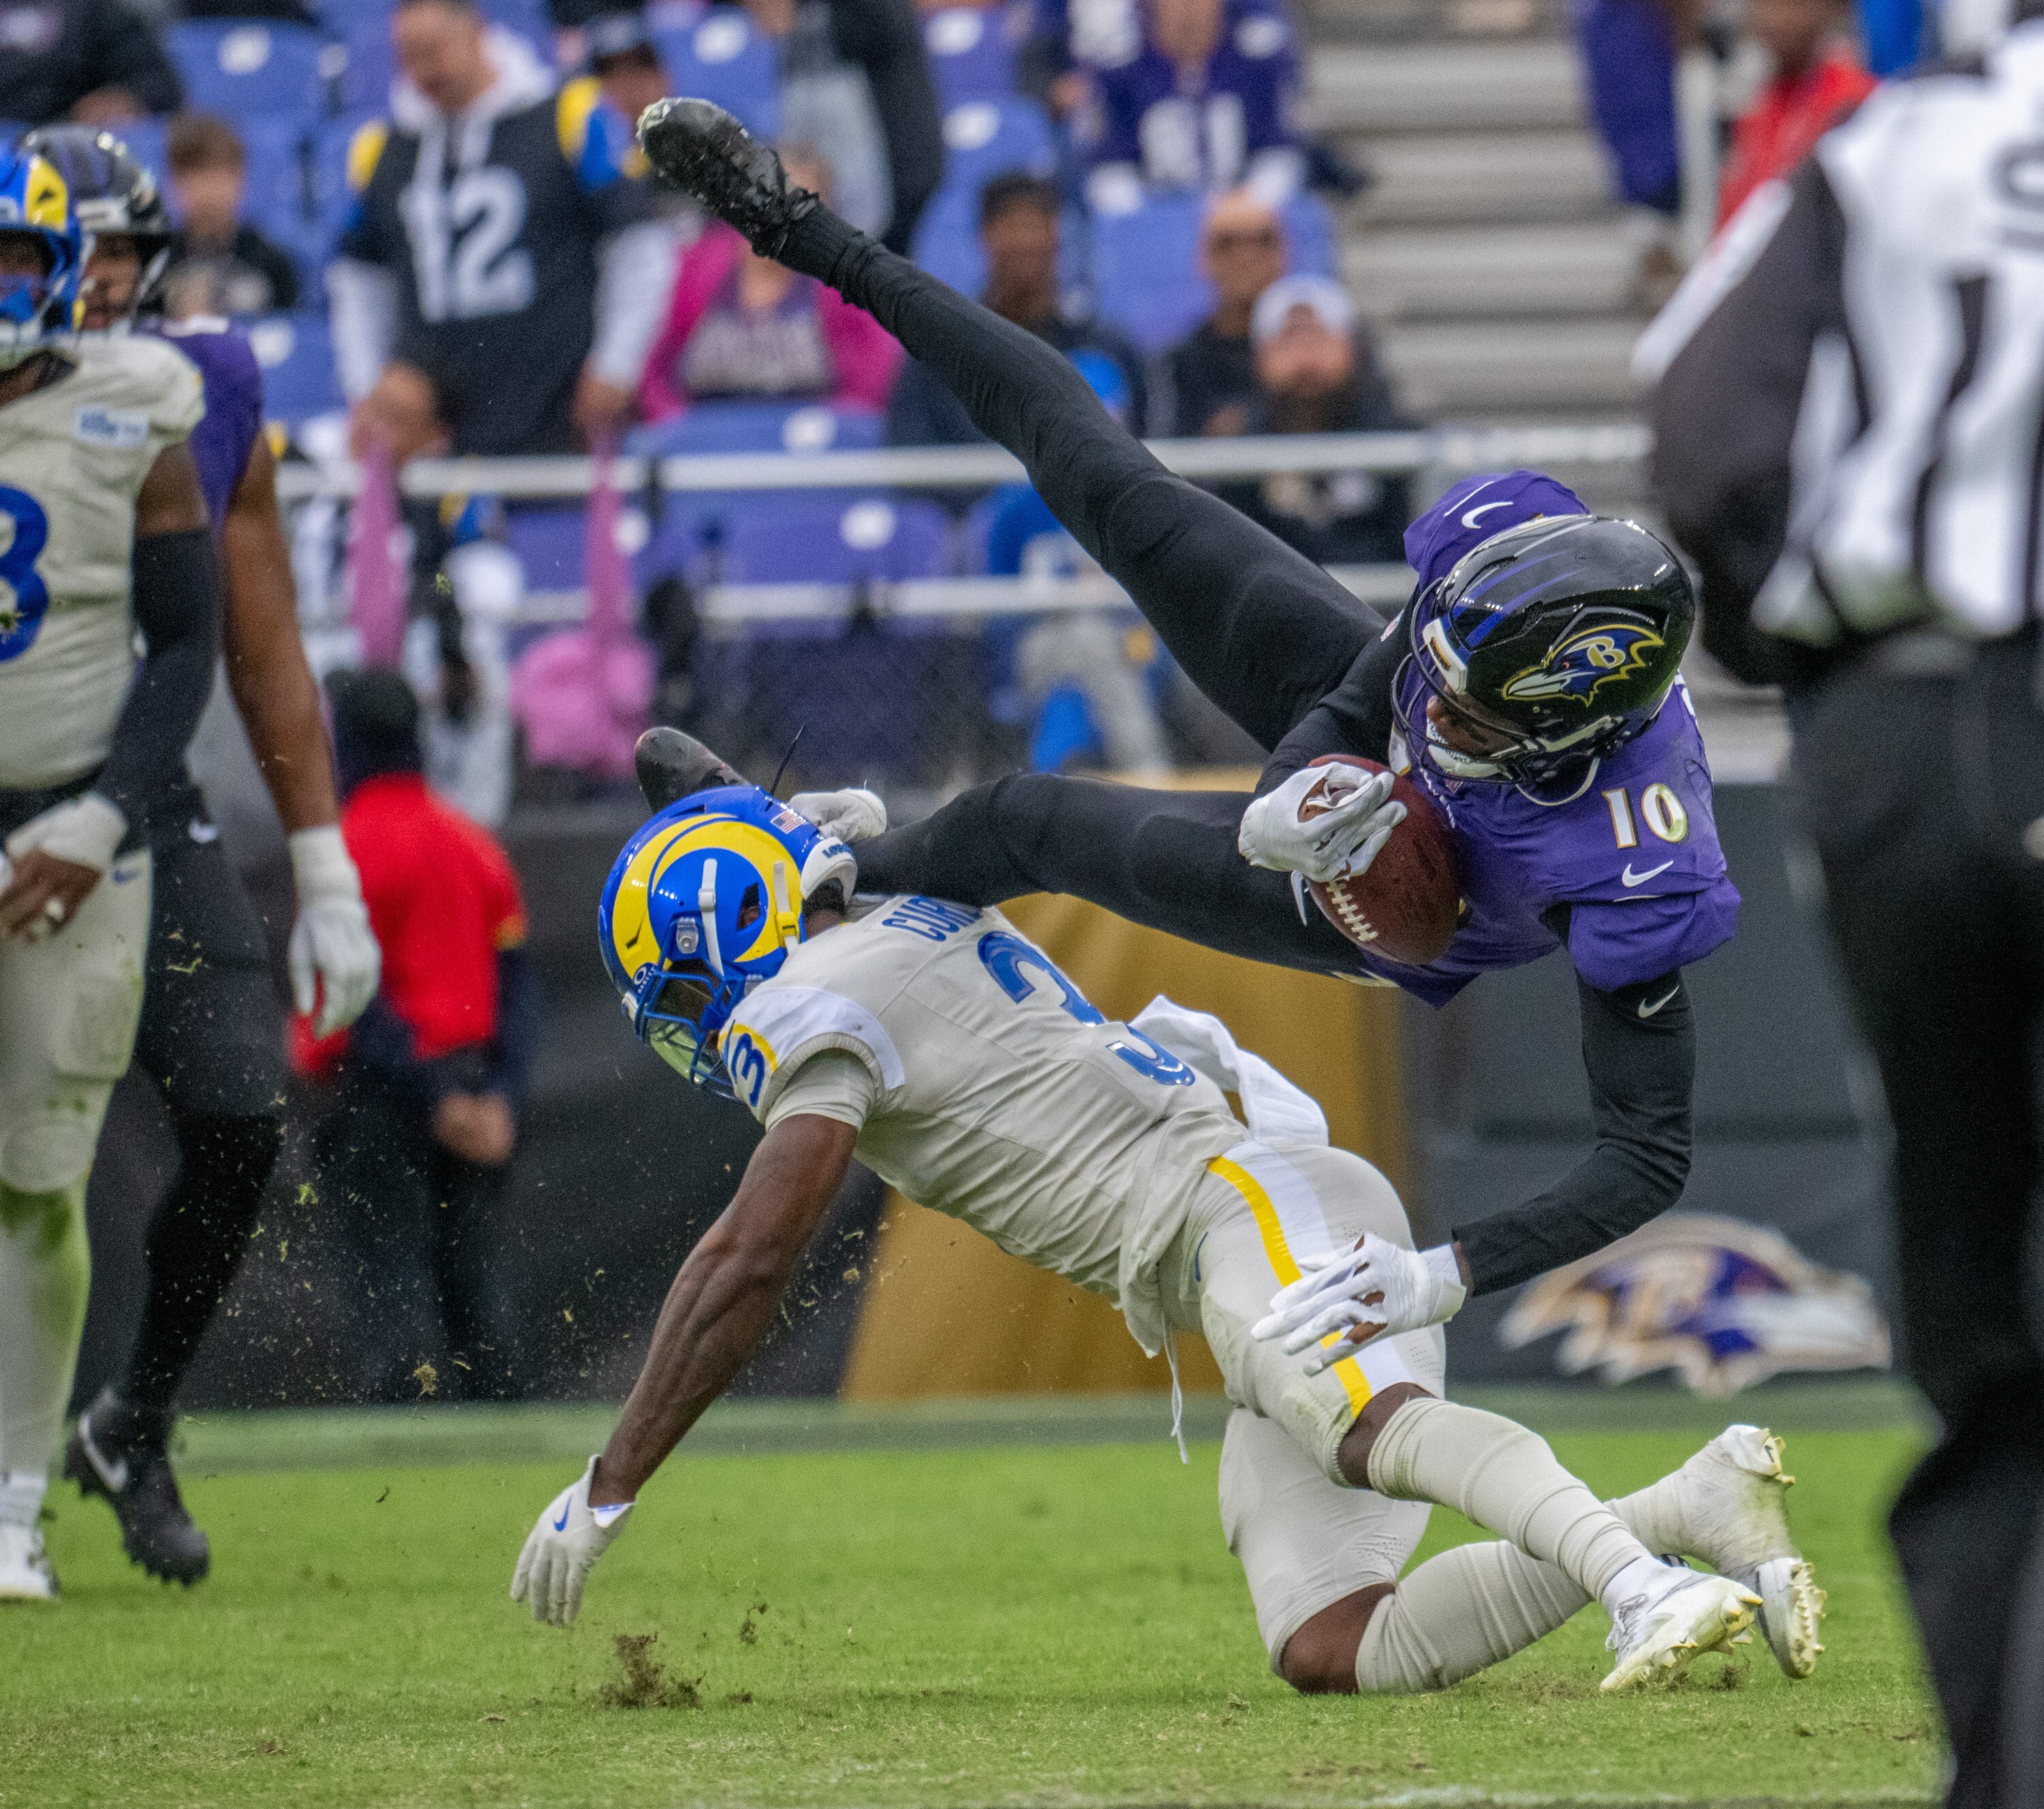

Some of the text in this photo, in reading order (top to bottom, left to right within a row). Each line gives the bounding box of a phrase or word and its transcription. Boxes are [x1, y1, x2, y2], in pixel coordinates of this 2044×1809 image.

[398, 167, 536, 322] 12
[1564, 636, 1626, 669] B
[1602, 783, 1688, 849] 10
[882, 895, 983, 942] CUR
[730, 1032, 765, 1107] 3
